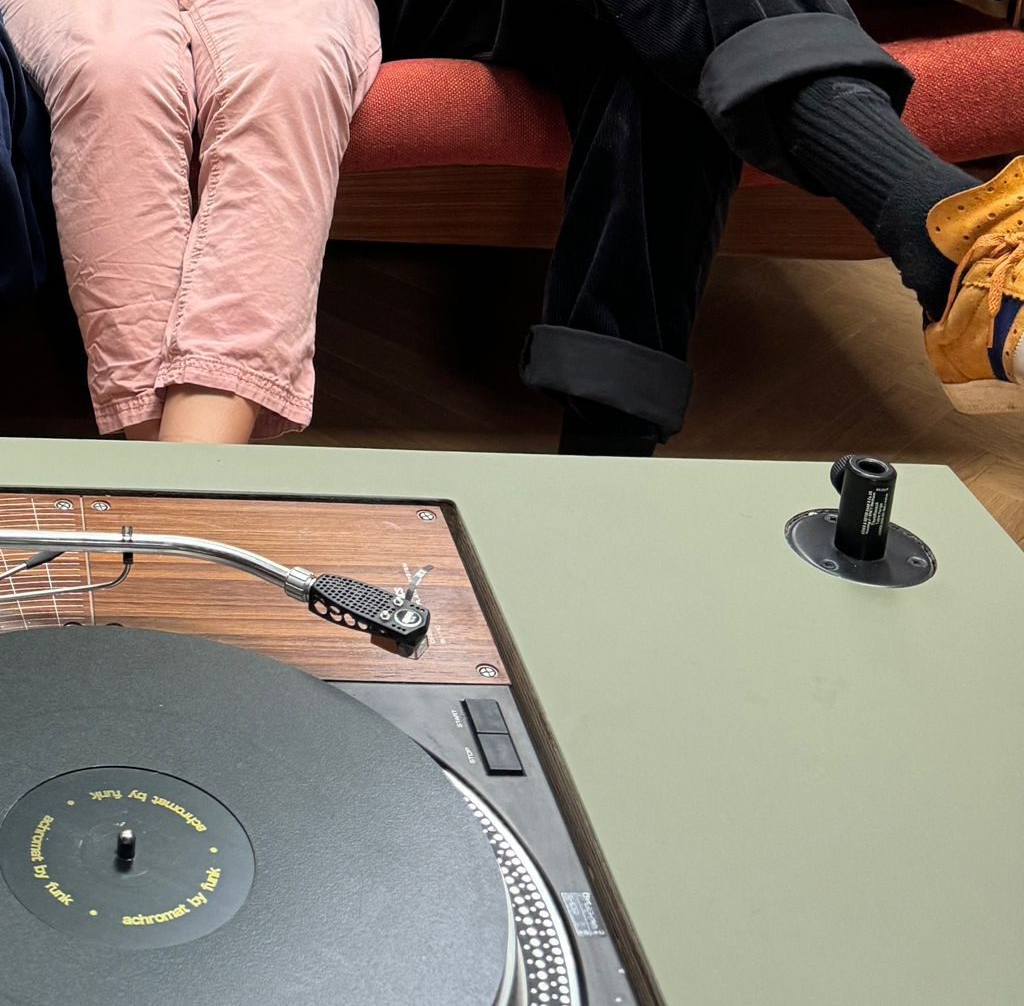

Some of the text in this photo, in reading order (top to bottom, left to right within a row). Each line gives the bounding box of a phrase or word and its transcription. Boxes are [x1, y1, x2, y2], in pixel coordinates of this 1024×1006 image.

[89, 790, 208, 833] achromat by funk
[30, 815, 74, 906] achromat by funk
[122, 867, 222, 926] achromat by funk
